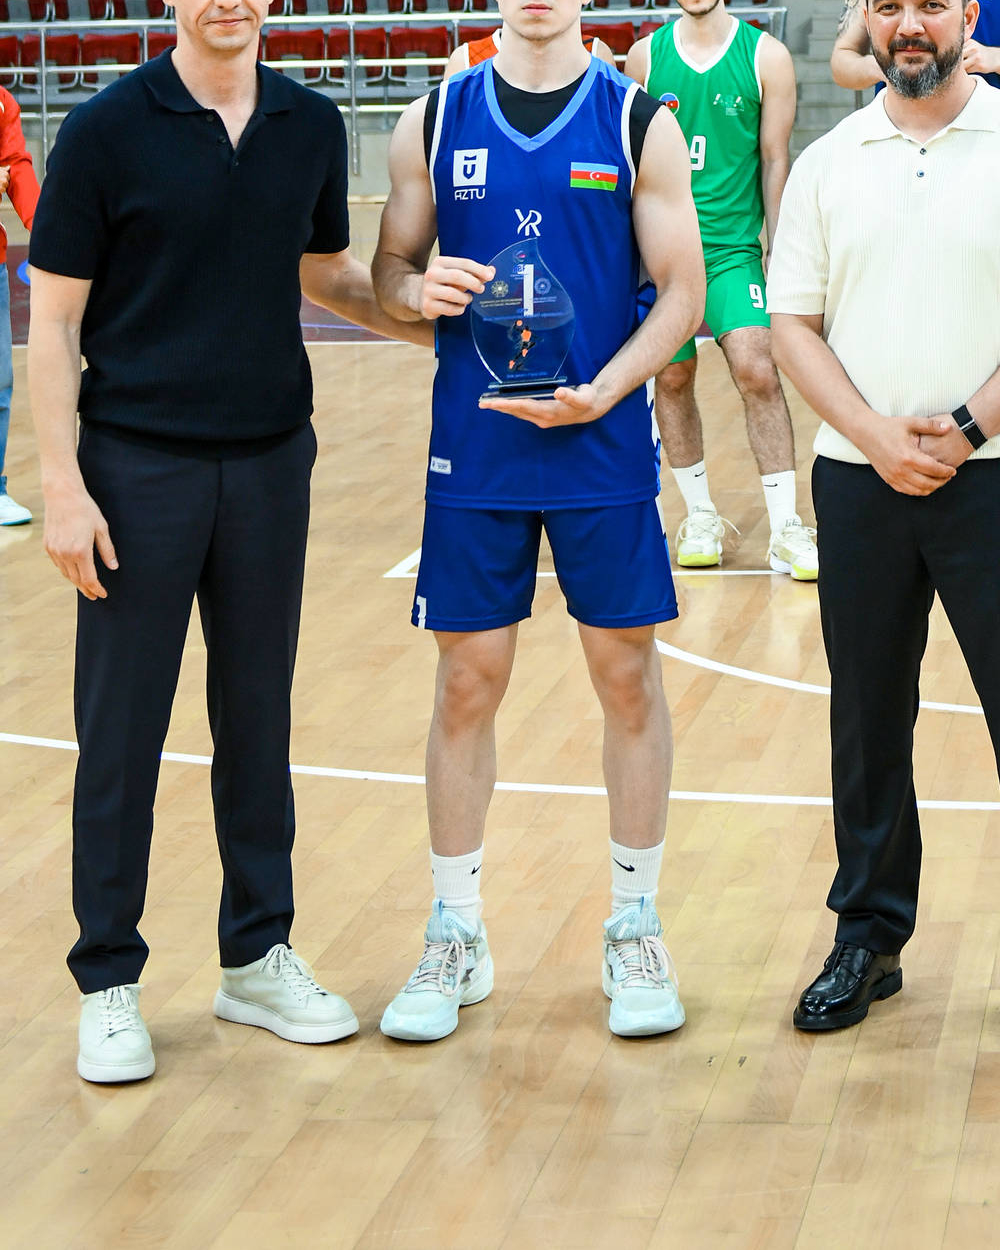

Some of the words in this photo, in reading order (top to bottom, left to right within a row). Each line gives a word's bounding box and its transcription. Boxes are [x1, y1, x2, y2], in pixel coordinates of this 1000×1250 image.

[690, 135, 707, 171] 9
[454, 188, 486, 201] AZTU
[748, 283, 764, 310] 9
[416, 595, 427, 630] 1
